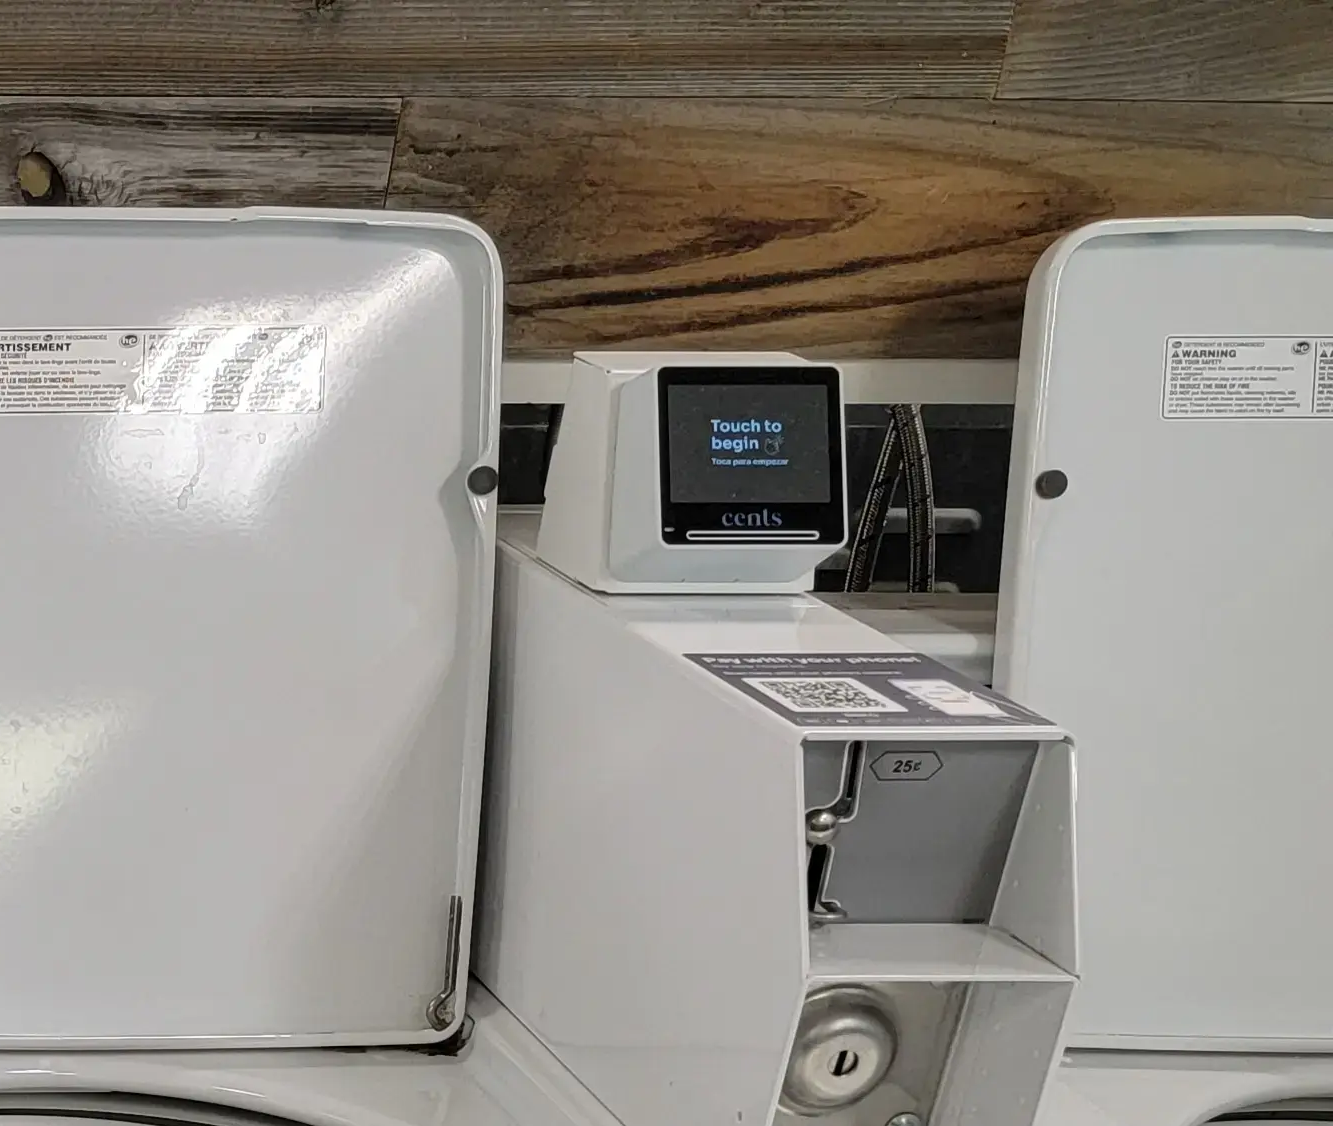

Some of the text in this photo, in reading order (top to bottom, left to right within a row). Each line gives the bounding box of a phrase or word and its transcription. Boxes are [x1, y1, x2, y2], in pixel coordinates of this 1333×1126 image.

[1182, 349, 1237, 358] WARNING
[710, 419, 783, 433] Touch to
[711, 436, 760, 453] begin
[711, 458, 732, 466] Toca
[733, 458, 752, 467] para
[722, 508, 783, 527] cents
[702, 657, 741, 665] Pay
[794, 657, 842, 665] your
[845, 656, 922, 665] phone!
[891, 760, 923, 773] 25¢
